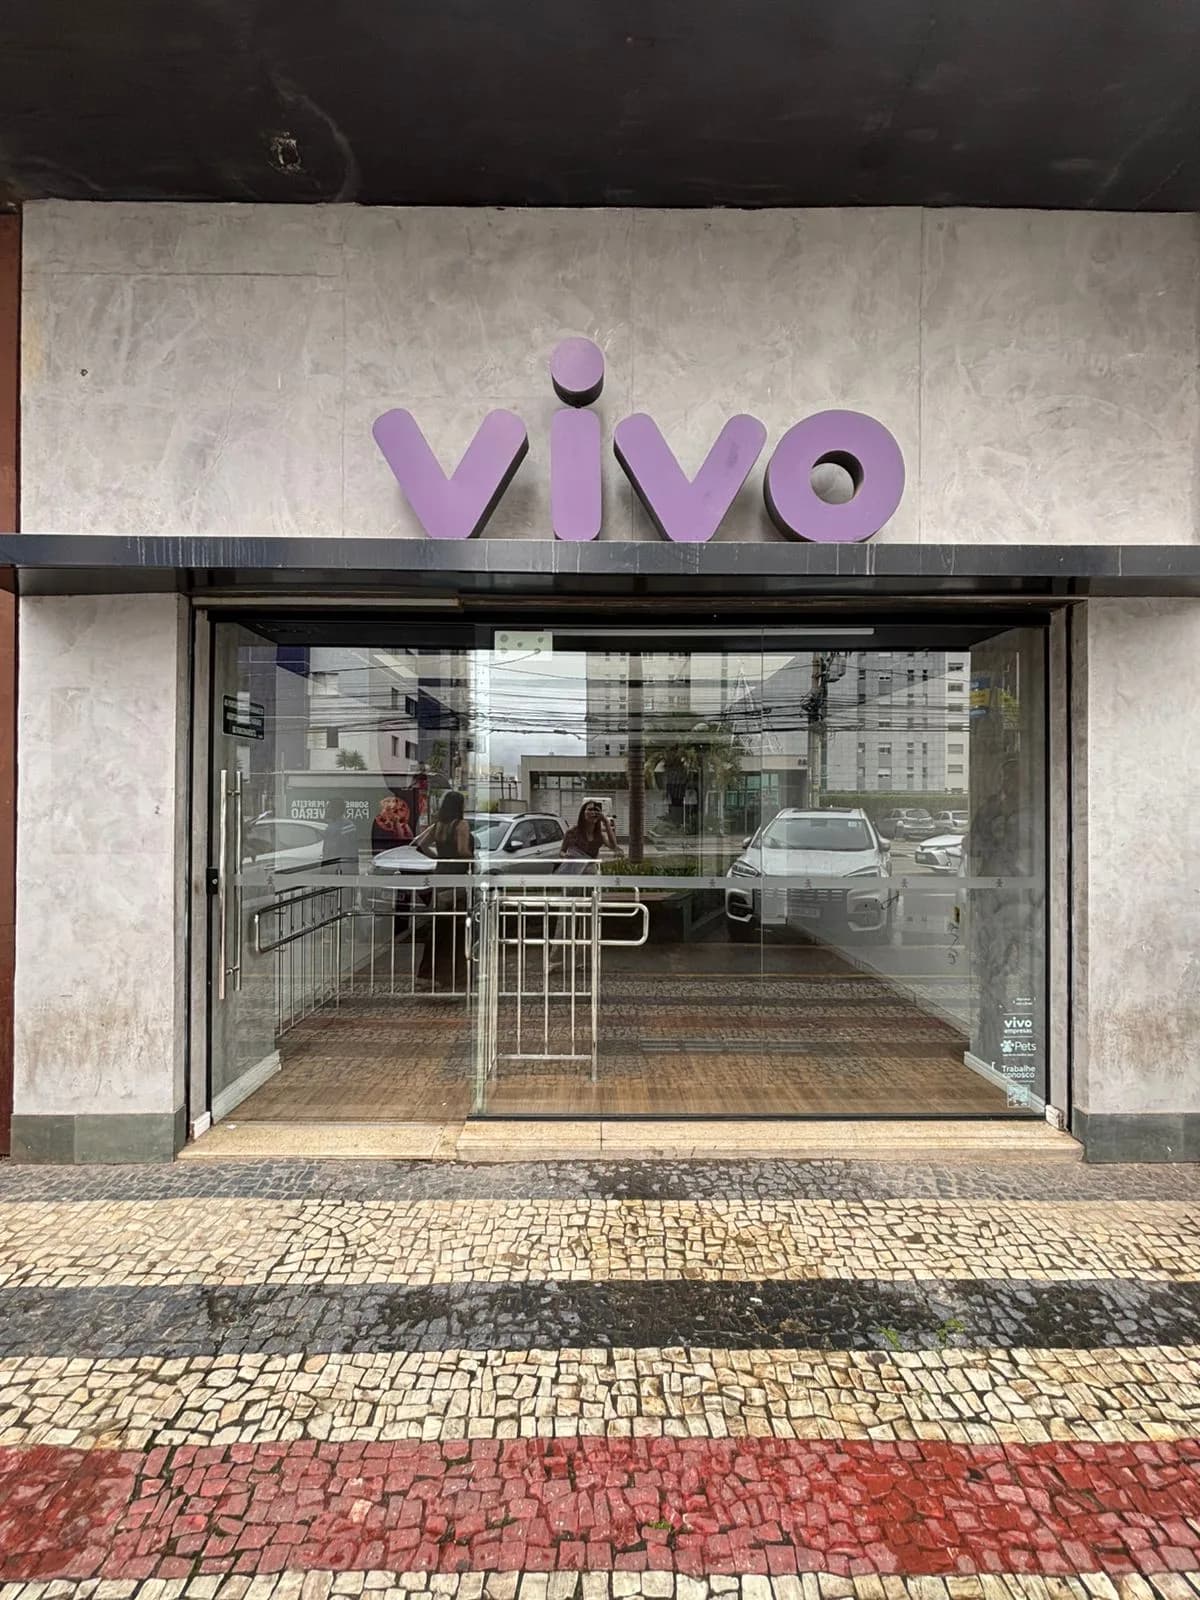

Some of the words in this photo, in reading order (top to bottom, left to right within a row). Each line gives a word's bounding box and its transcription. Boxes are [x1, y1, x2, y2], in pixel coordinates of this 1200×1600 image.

[372, 336, 905, 542] vivo
[1004, 1017, 1032, 1028] vivo
[1015, 1041, 1036, 1051] Pets
[1003, 1071, 1035, 1079] conosco
